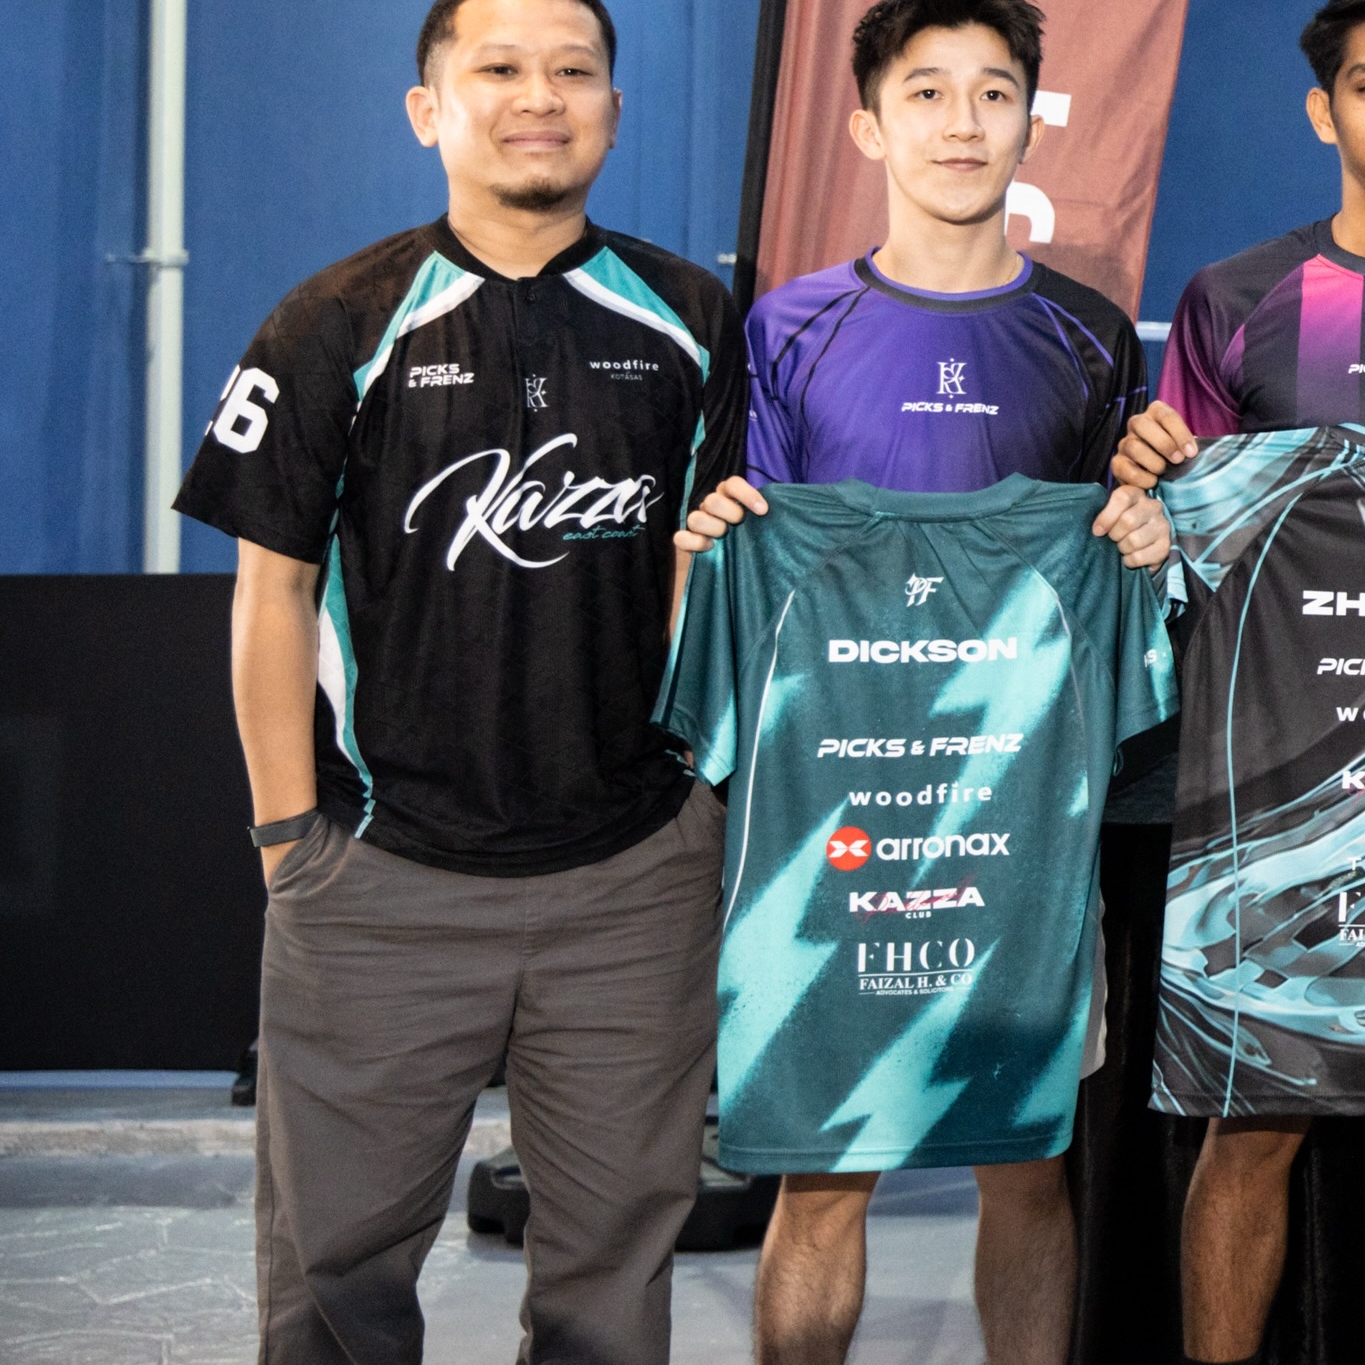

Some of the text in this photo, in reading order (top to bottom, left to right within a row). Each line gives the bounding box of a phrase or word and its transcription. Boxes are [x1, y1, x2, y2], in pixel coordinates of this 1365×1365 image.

[409, 363, 460, 378] PICKS
[589, 359, 659, 371] woodfire
[408, 372, 475, 388] & FRENZ
[204, 364, 280, 453] 6
[901, 401, 999, 415] PICKS & FRENZ
[828, 636, 1018, 664] DICKSON
[817, 733, 1024, 758] PICKS & FRENZ
[849, 780, 993, 806] woodfire
[876, 833, 1011, 861] arronax
[849, 886, 986, 913] KAZZA
[905, 910, 932, 920] CLUB
[858, 938, 975, 973] FHCO
[859, 972, 973, 991] FAIZAL H. & CO
